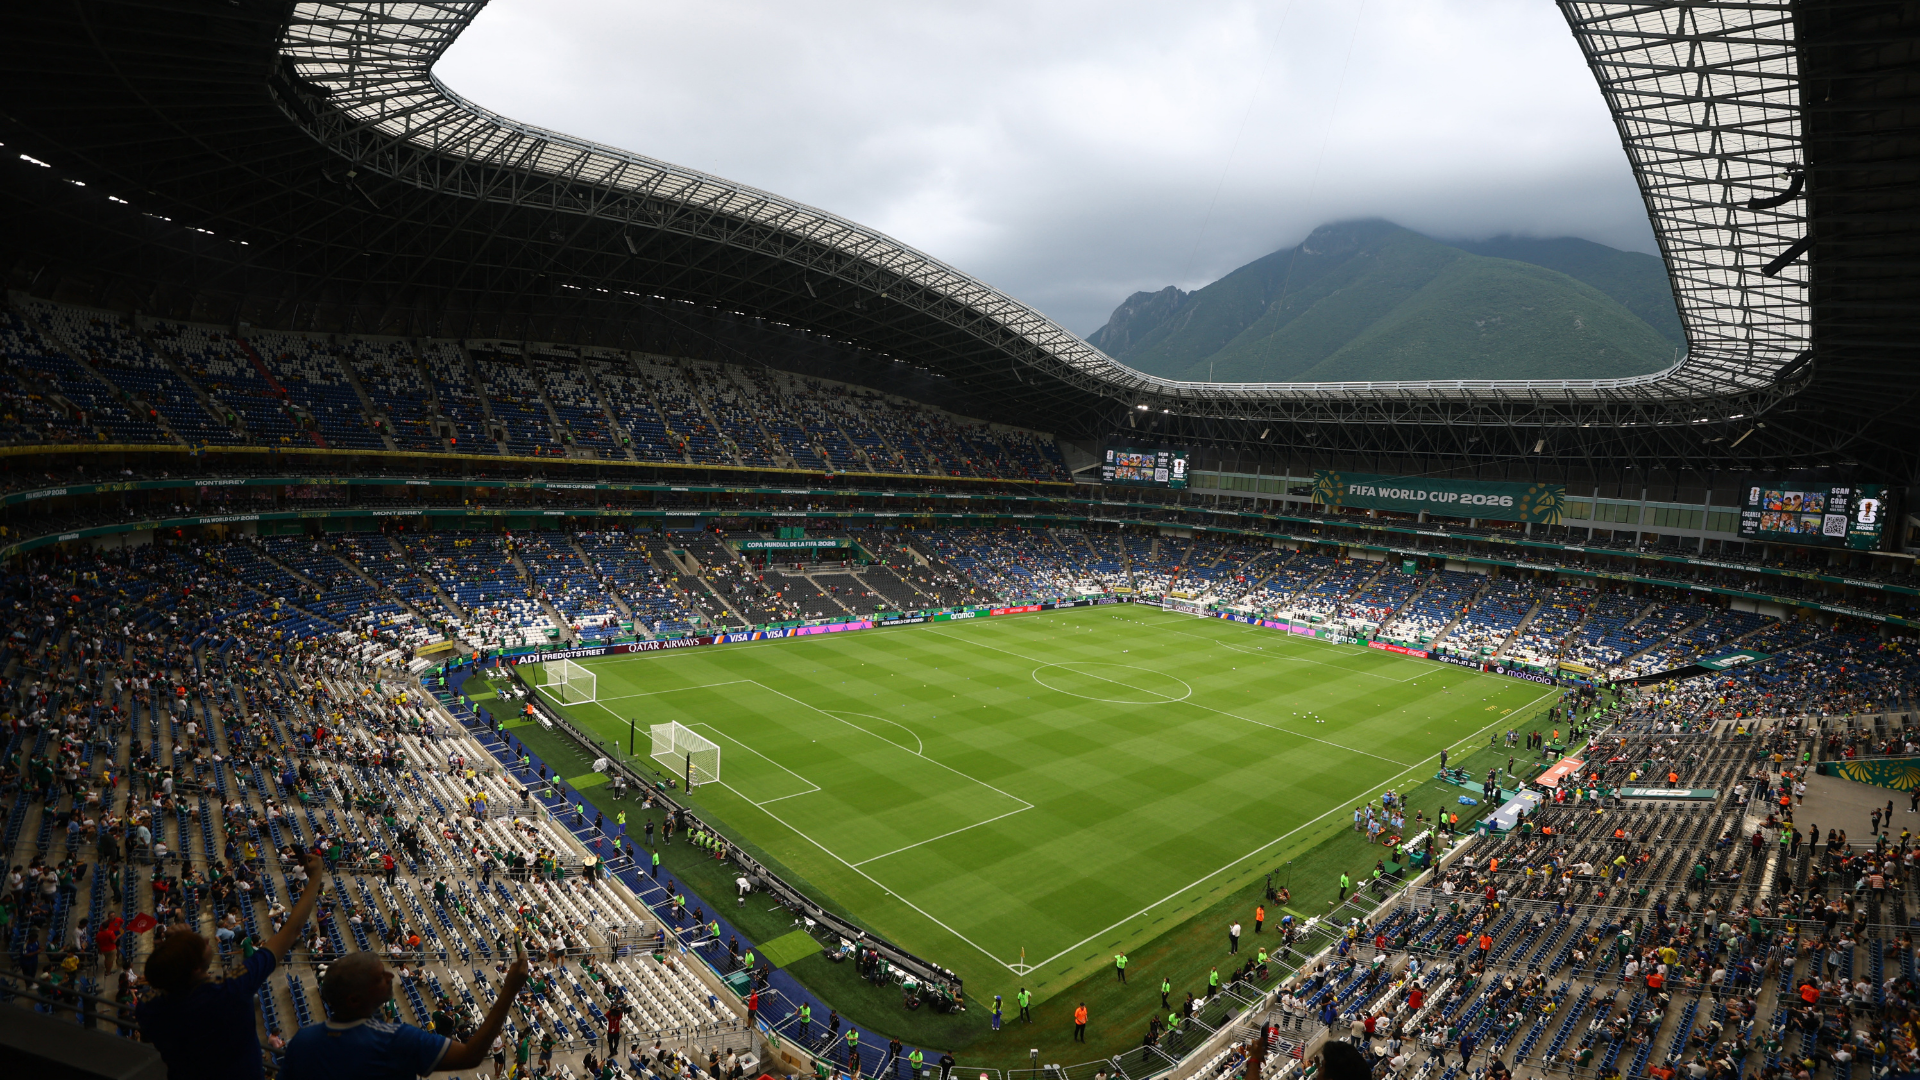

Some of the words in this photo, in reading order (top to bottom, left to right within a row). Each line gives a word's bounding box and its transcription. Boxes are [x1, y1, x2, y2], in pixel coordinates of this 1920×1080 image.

[1350, 485, 1376, 496] FIFA
[1379, 488, 1427, 500] WORLD
[1429, 492, 1457, 503] CUP
[1460, 494, 1513, 507] 2026
[1844, 580, 1884, 589] MONTERREY
[730, 634, 748, 642] VISA
[766, 630, 783, 639] VISA
[629, 641, 659, 652] QATAR
[663, 638, 699, 649] AIRWAYS
[1368, 641, 1386, 650] Coca-Cola
[518, 654, 539, 665] ADI
[542, 648, 606, 660] PREDICTSTREET
[1407, 649, 1426, 658] Coca-Cola
[1508, 670, 1551, 685] motorola
